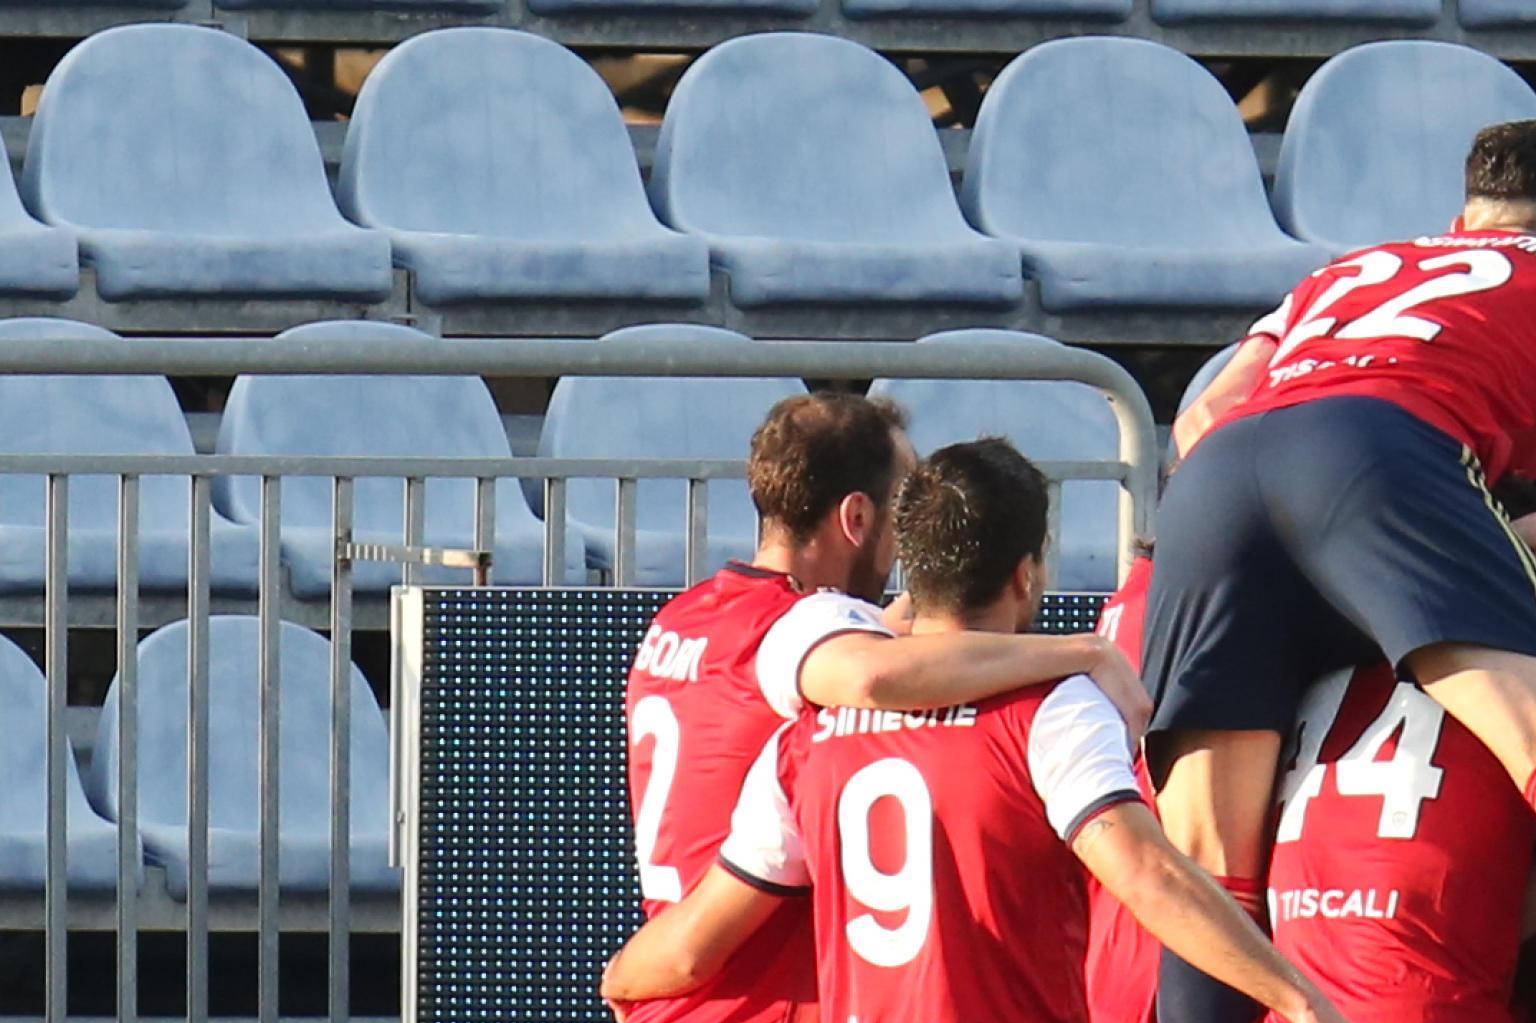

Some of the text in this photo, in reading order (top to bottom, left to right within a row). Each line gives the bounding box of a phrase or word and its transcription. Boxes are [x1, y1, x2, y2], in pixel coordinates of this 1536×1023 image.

[1268, 250, 1514, 369] 22
[631, 694, 683, 904] 2
[838, 756, 934, 967] 9
[1281, 889, 1400, 921] TISCALI
